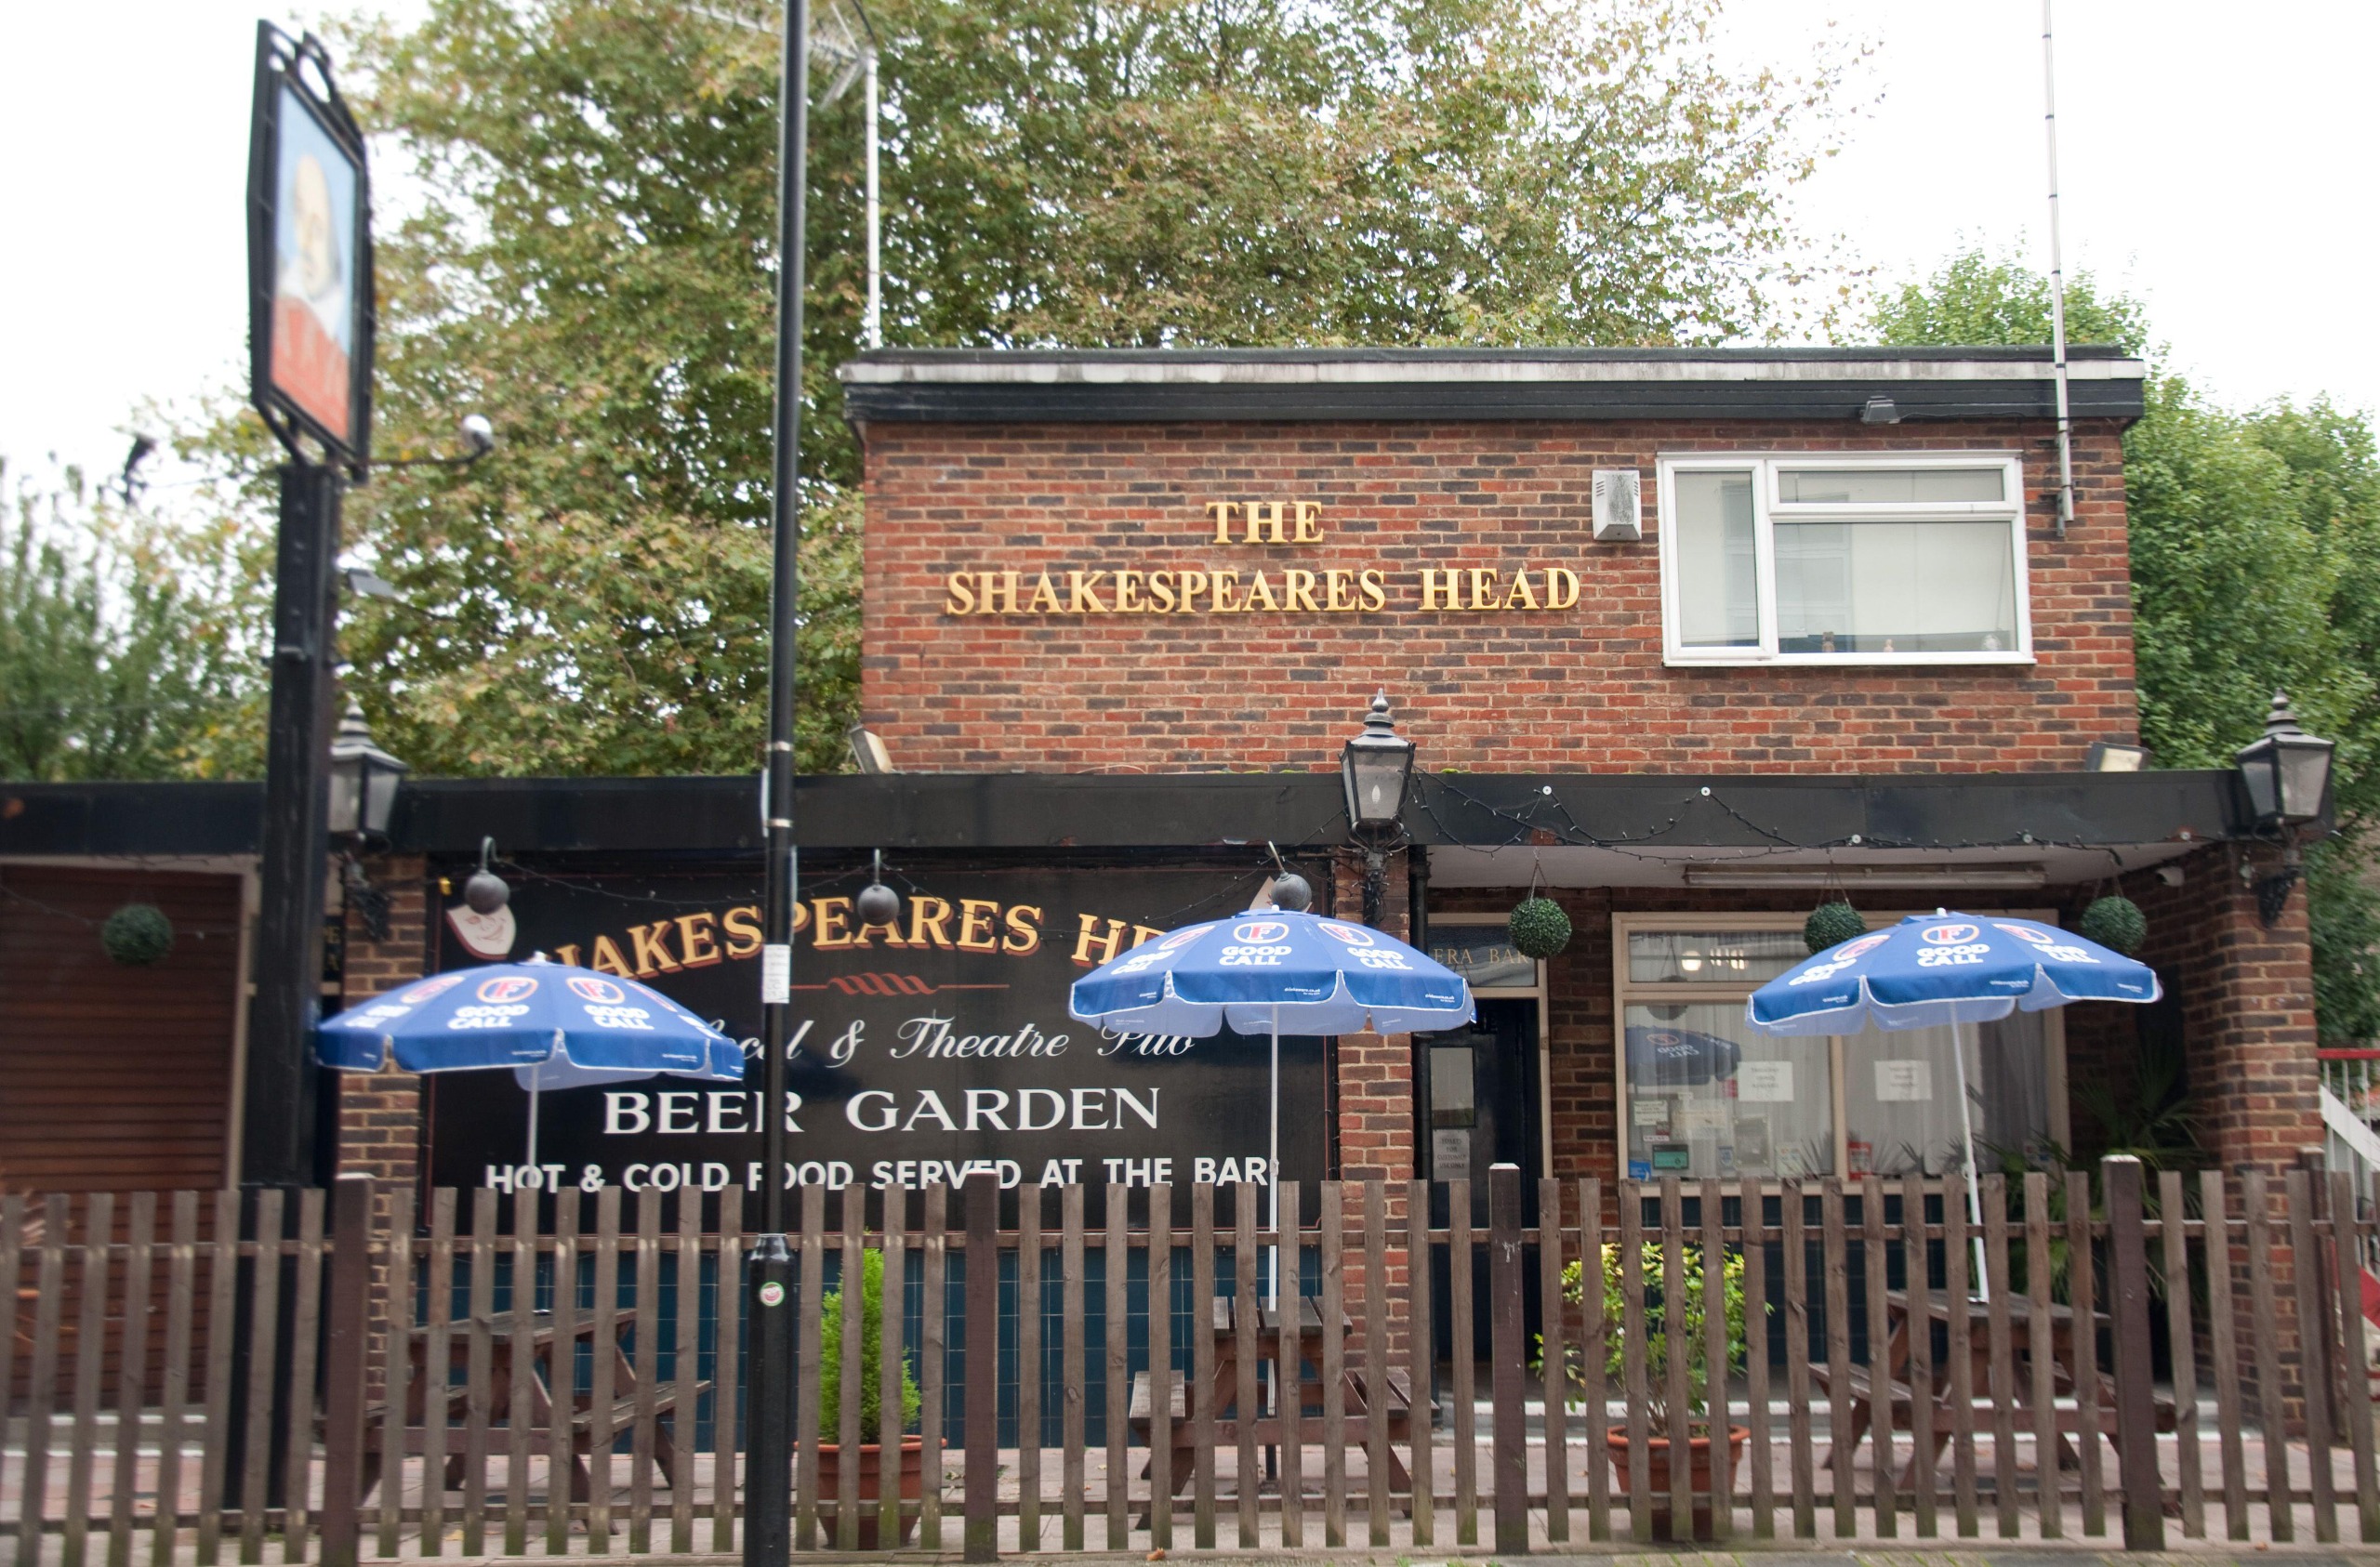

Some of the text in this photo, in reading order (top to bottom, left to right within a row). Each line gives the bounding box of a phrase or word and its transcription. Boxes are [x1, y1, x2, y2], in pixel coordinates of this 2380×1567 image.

[1206, 500, 1324, 544] THE
[945, 566, 1580, 615] SHAKESPEARES HEAD
[1220, 945, 1292, 956] GOOD
[1346, 946, 1405, 960] GOOD
[1916, 944, 1990, 958] GOOD
[1219, 955, 1283, 966] CALL
[1358, 957, 1414, 970] CALL
[1917, 955, 1984, 968] CALL
[456, 1005, 531, 1018] GOOD
[583, 1004, 651, 1019] GOOD
[447, 1016, 513, 1030] CALL
[593, 1016, 655, 1030] CALL
[826, 1019, 866, 1068] &
[890, 1015, 1071, 1060] Theatre
[603, 1086, 1162, 1135] BEER GARDEN
[486, 1163, 565, 1194] HOT
[579, 1164, 606, 1192] &
[623, 1162, 731, 1193] COLD
[1039, 1158, 1083, 1189] AT
[1103, 1157, 1173, 1188] THE
[1195, 1156, 1268, 1188] BAR
